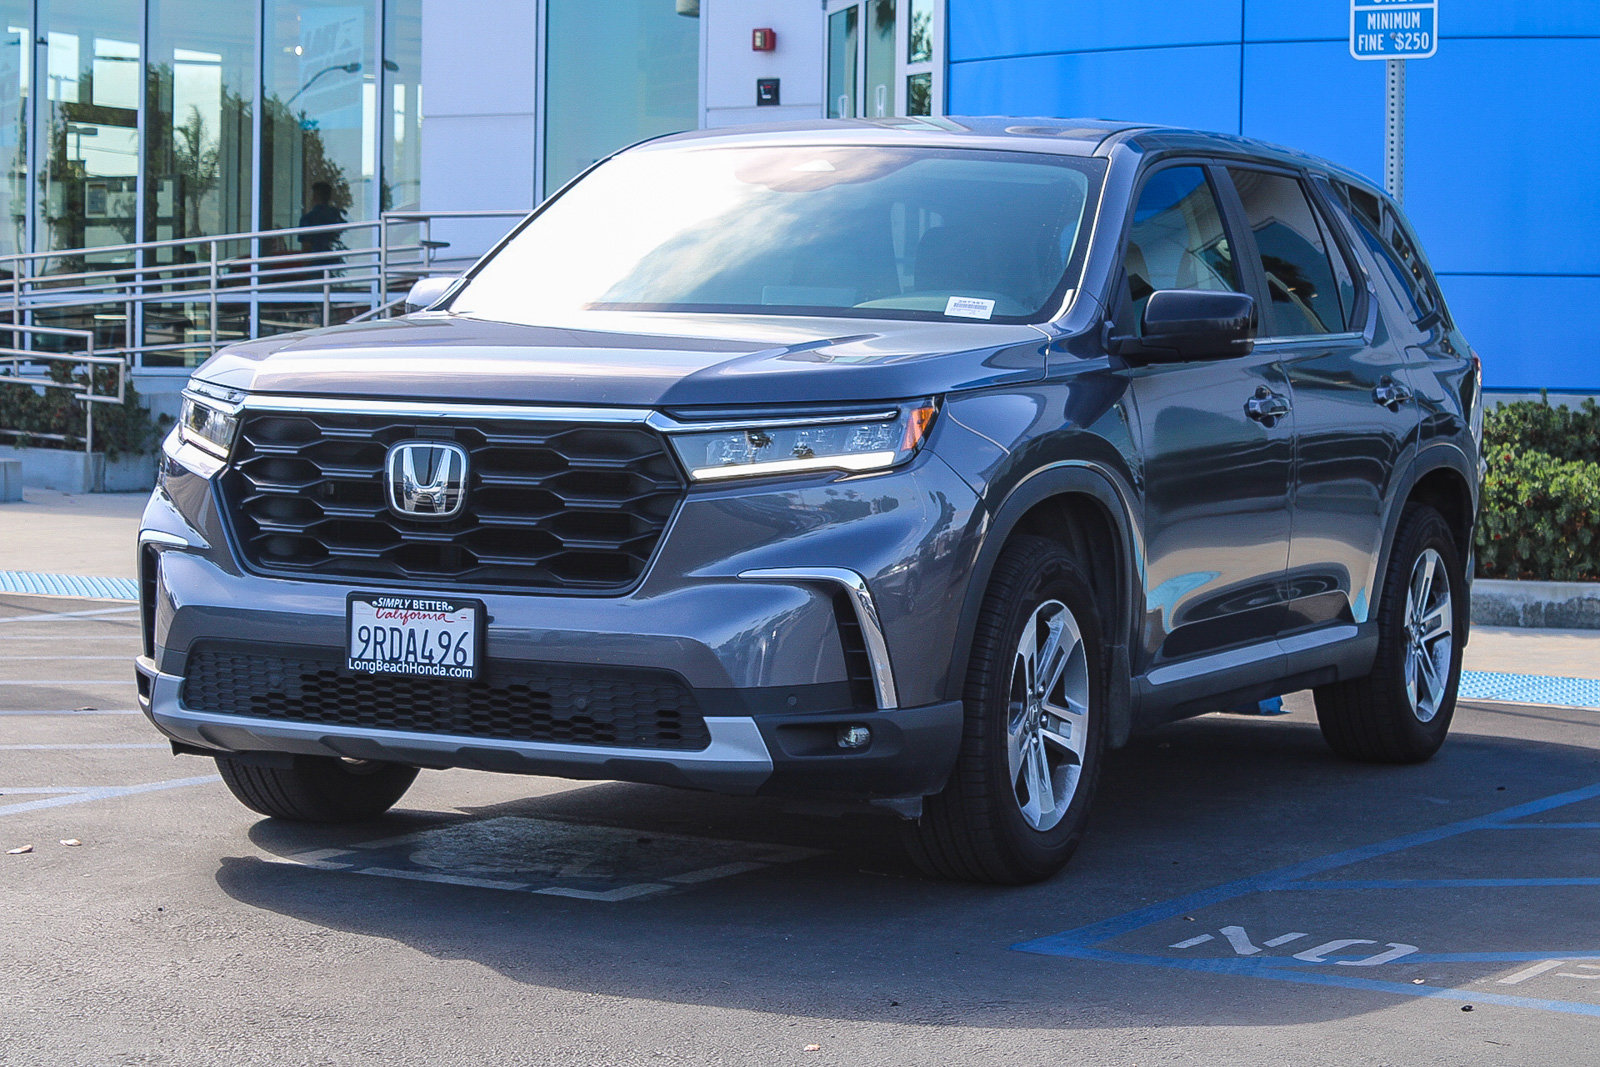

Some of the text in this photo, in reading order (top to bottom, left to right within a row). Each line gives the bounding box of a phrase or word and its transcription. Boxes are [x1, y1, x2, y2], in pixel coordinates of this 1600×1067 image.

[1367, 11, 1421, 30] MINIMUM
[1358, 31, 1430, 51] FINE $250
[378, 597, 449, 611] SIMPLY BETTER
[375, 607, 455, 626] California
[358, 625, 469, 667] 9RDA496
[348, 657, 473, 678] LongBeachHonda.com
[1168, 925, 1420, 967] NO
